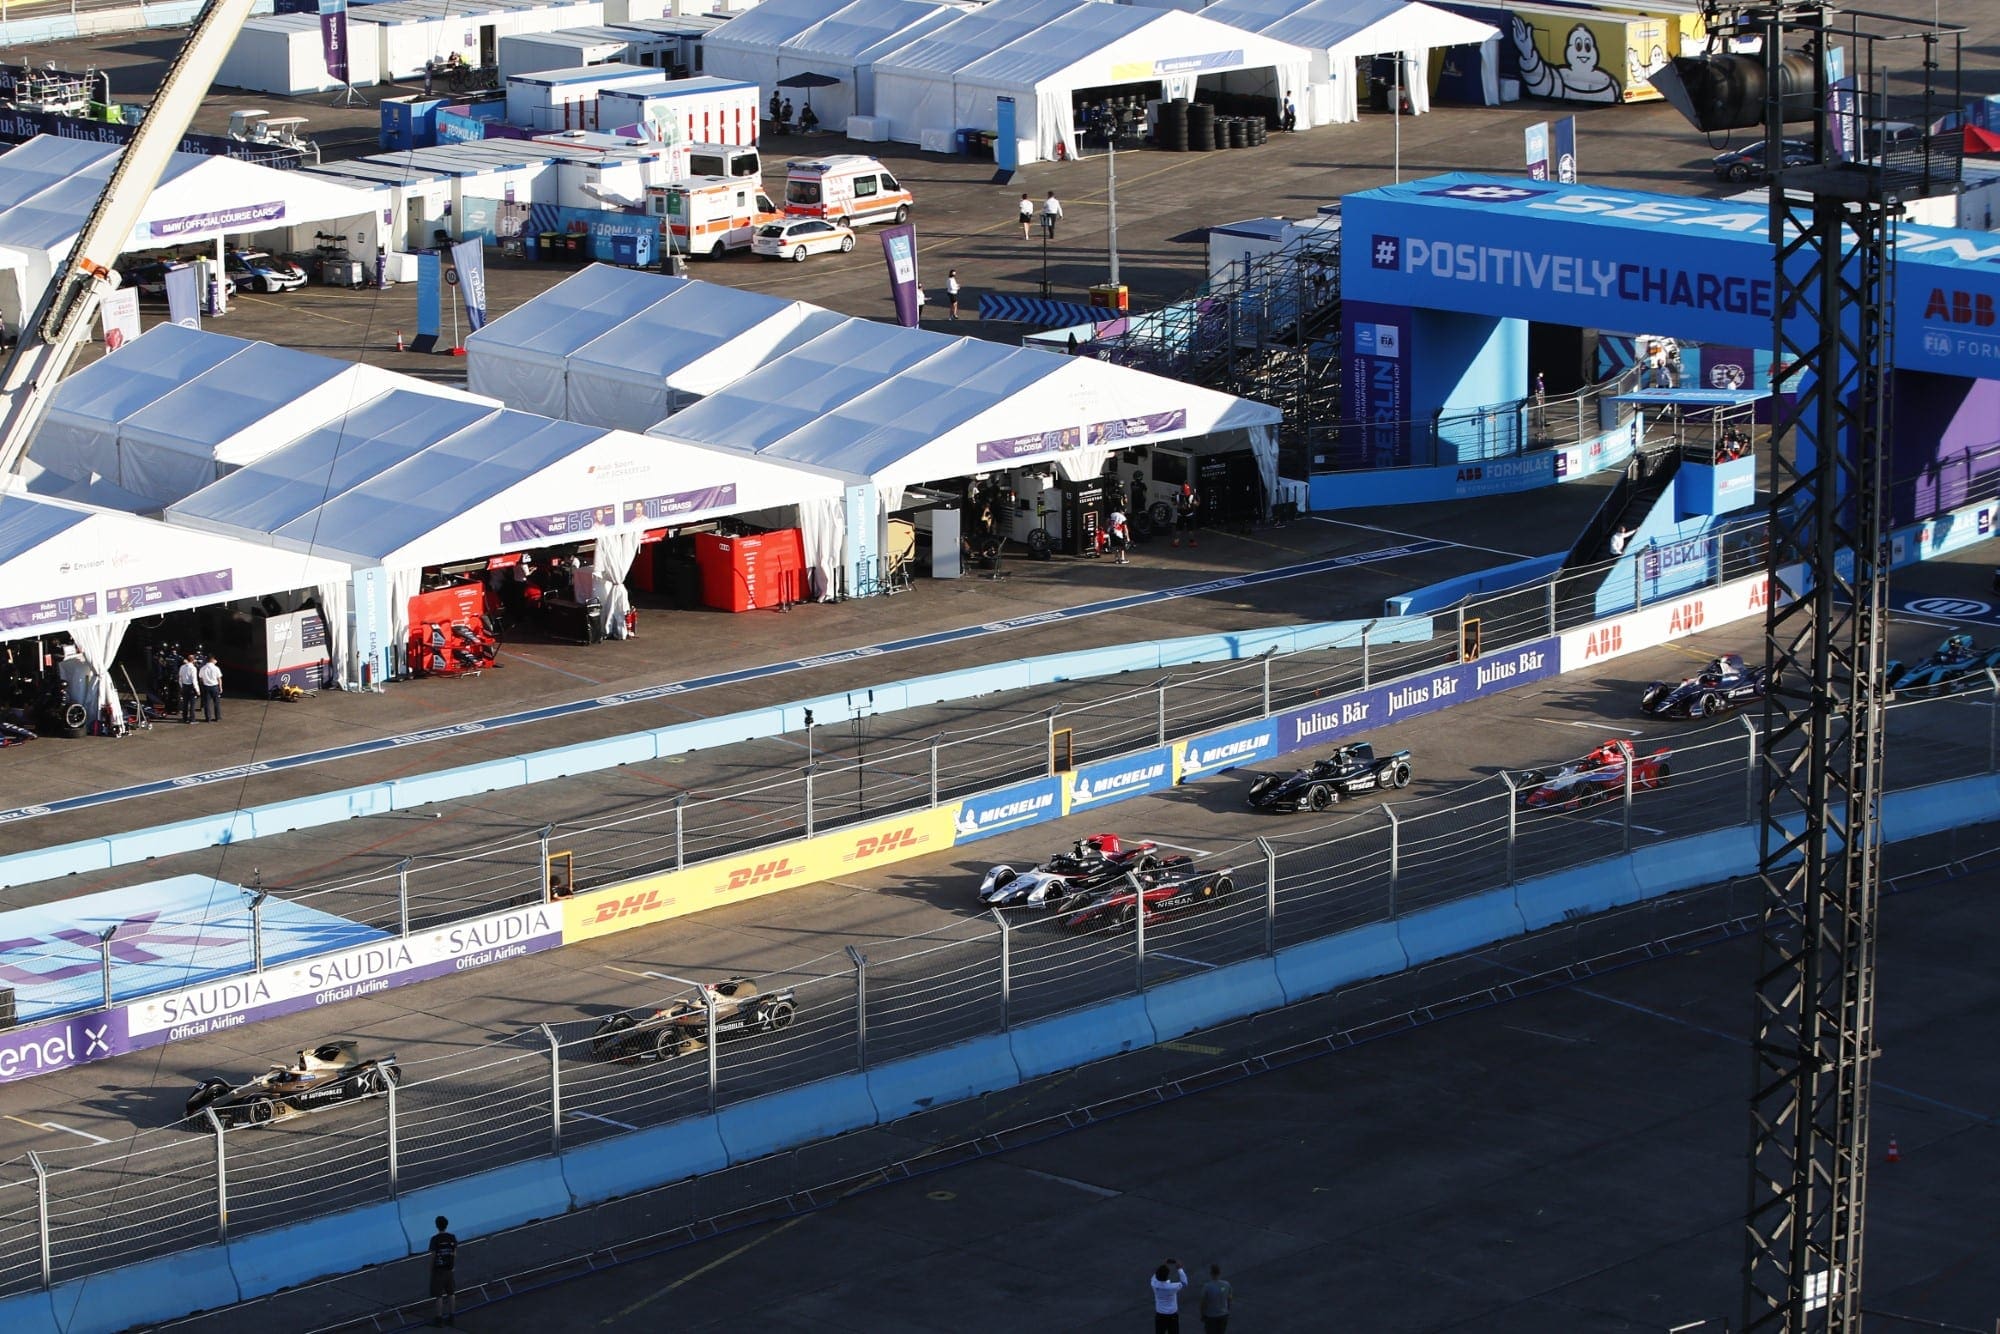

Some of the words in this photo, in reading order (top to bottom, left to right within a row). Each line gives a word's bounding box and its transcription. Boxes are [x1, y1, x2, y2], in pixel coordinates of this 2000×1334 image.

[0, 71, 17, 89] är
[16, 116, 41, 136] Bär
[185, 217, 220, 230] OFFICIAL
[220, 211, 252, 224] COURSE
[252, 207, 274, 219] CARS
[1924, 288, 1995, 327] ABB
[1925, 335, 1950, 353] FIA
[1374, 360, 1393, 468] BERLIN
[1024, 441, 1042, 451] COSTA
[1456, 467, 1482, 482] ABB
[567, 510, 594, 533] 66
[668, 501, 692, 512] GRASSI
[549, 522, 566, 533] RAST
[1662, 538, 1711, 568] BERLIN
[145, 591, 162, 601] BIRD
[1669, 601, 1704, 635] ABB
[1585, 624, 1623, 660] ABB
[1476, 655, 1516, 690] Julius
[1517, 649, 1545, 676] Bär
[1388, 682, 1428, 717] Julius
[1431, 675, 1459, 702] Bär
[1296, 708, 1339, 742] Julius
[1342, 700, 1370, 727] Bär
[392, 728, 458, 746] Allianz
[1202, 733, 1270, 763] MICHELIN
[1093, 763, 1165, 793] MICHELIN
[979, 793, 1054, 825] MICHELIN
[854, 827, 918, 859] DHL
[727, 858, 794, 890] DHL
[595, 890, 663, 923] DHL
[1157, 897, 1193, 909] NISSAN
[450, 910, 550, 953] SAUDIA
[309, 944, 413, 988] SAUDIA
[456, 951, 492, 970] Official
[495, 943, 527, 960] Airline
[163, 979, 271, 1023] SAUDIA
[315, 985, 353, 1006] Official
[355, 976, 389, 996] Airline
[170, 1018, 209, 1041] Official
[211, 1012, 245, 1034] Airline
[0, 1025, 75, 1077] enel
[309, 1087, 343, 1099] AUTOMOBILES
[276, 1105, 286, 1115] 13
